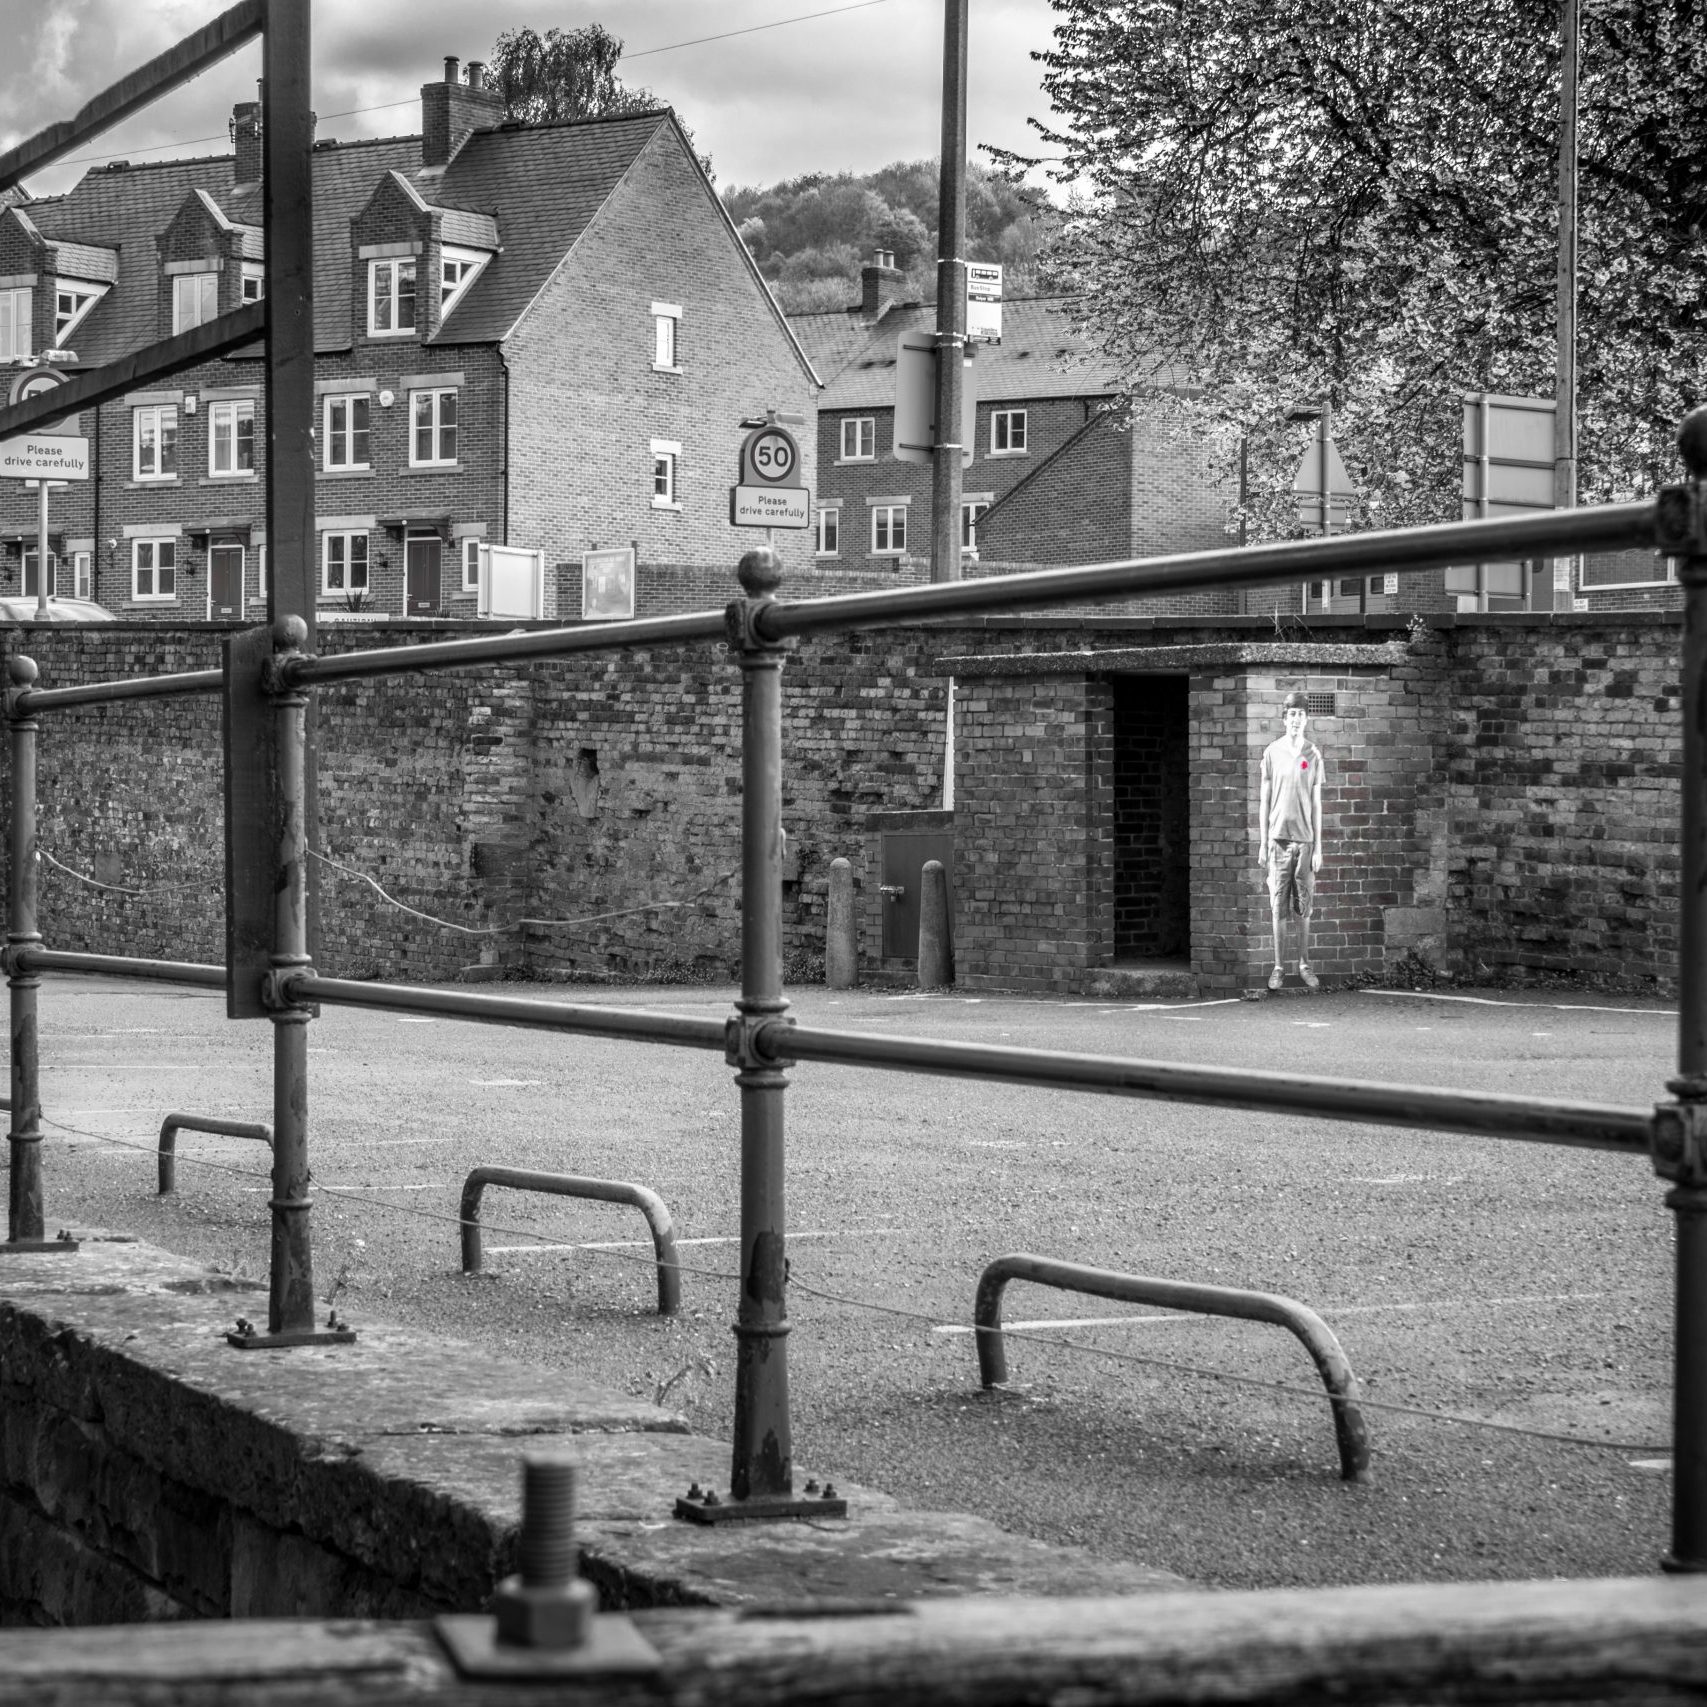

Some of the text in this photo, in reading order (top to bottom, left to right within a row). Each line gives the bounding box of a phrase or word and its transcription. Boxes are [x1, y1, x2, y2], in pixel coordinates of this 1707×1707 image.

[27, 445, 63, 456] Please
[758, 446, 789, 467] 50
[4, 456, 85, 470] drive carefully
[758, 495, 788, 506] Please
[740, 506, 805, 519] drive carefully
